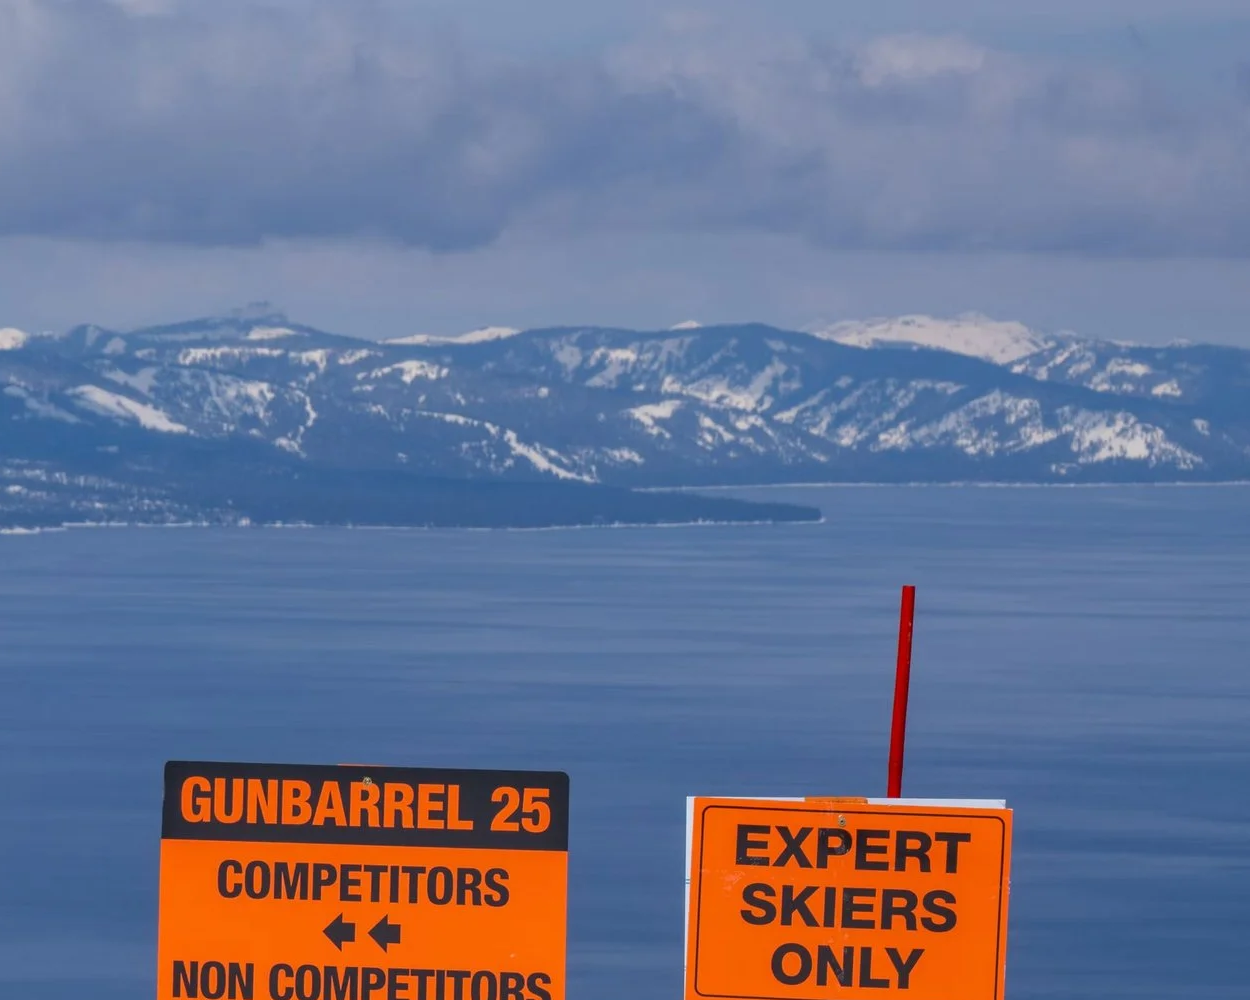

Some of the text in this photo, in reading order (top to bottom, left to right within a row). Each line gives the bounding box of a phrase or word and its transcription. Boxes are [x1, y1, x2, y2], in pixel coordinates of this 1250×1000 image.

[180, 775, 551, 833] GUNBARREL 25
[735, 823, 972, 875] EXPERT
[217, 859, 510, 908] COMPETITORS
[740, 883, 958, 933] SKIERS
[172, 959, 254, 1000] NON
[771, 943, 925, 990] ONLY
